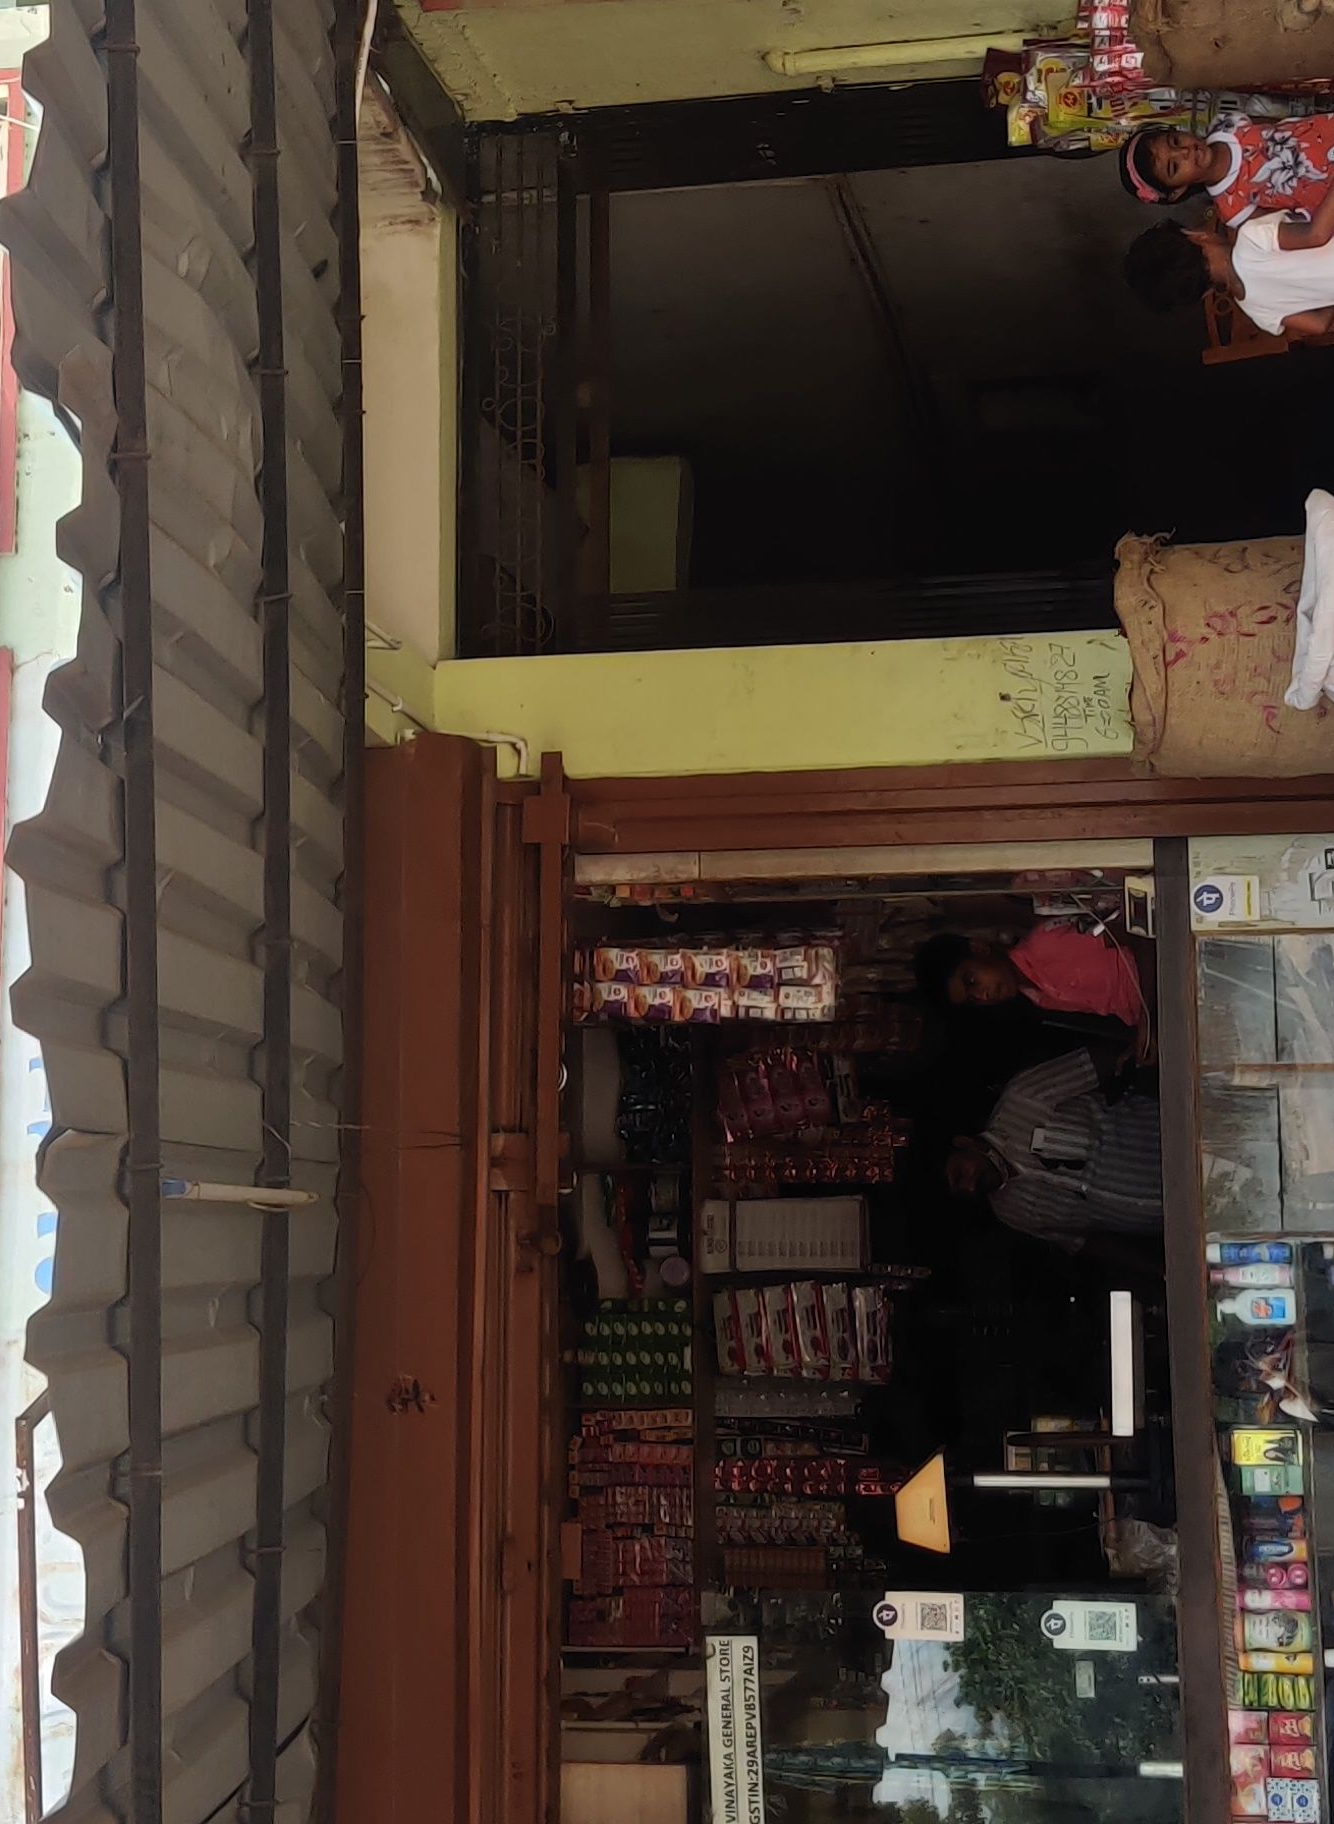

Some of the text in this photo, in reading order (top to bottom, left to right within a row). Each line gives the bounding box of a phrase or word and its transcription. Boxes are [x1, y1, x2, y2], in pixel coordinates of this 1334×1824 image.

[718, 1639, 736, 1823] VINAYAKA GENERAL STORE
